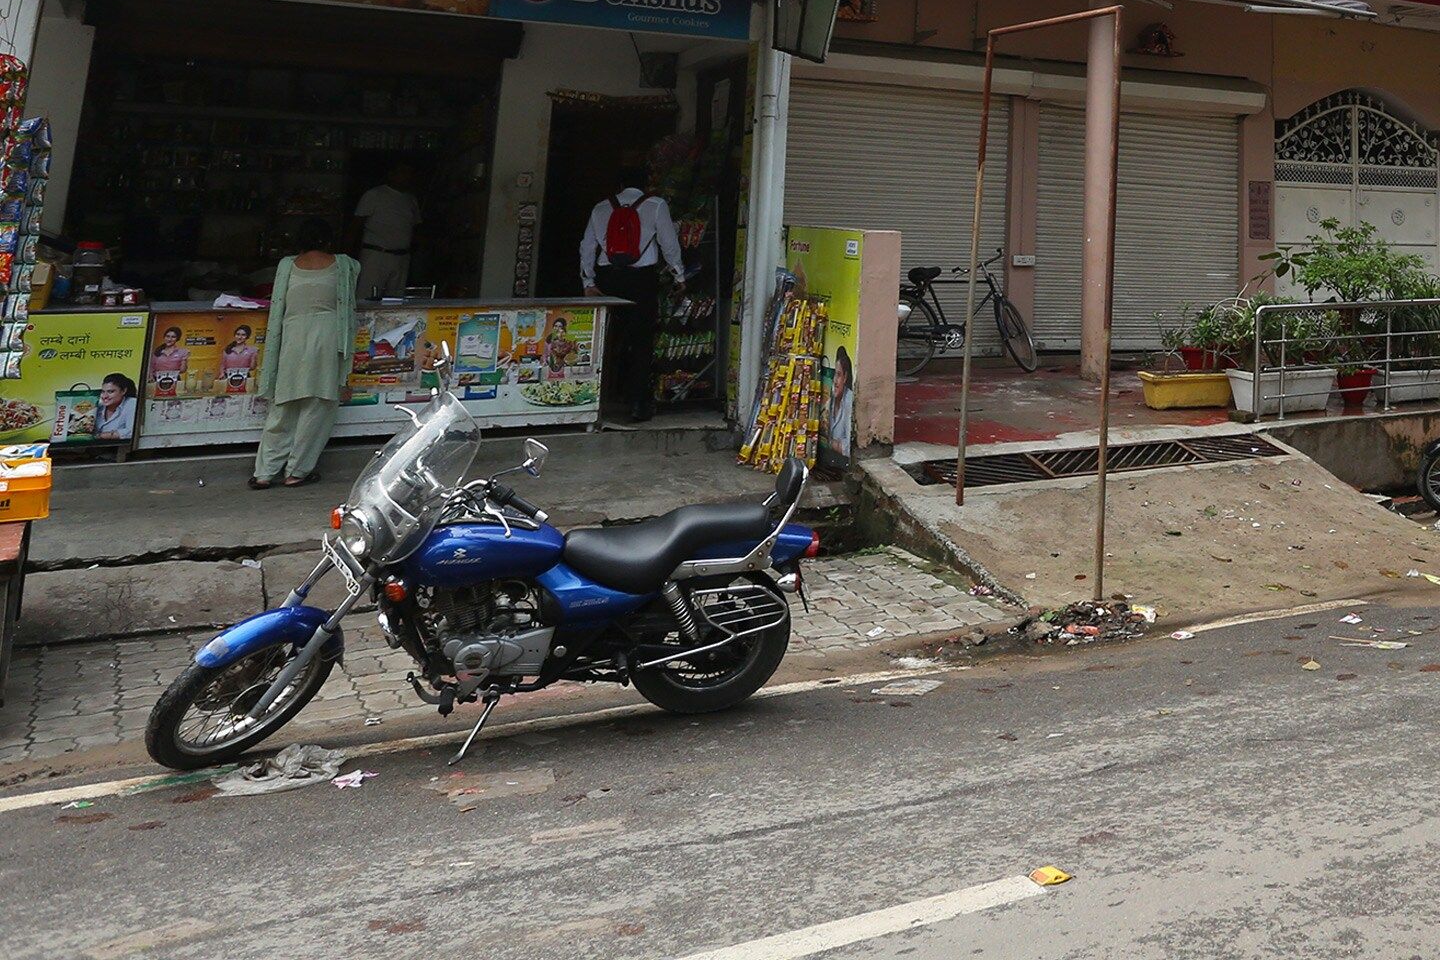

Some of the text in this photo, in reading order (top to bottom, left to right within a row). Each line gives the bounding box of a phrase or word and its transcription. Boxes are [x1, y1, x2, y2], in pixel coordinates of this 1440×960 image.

[627, 12, 710, 30] Gourmet Cookies
[40, 332, 91, 346] लम्बे दानों
[60, 347, 87, 361] लम्बी
[90, 348, 133, 360] फरमाइश
